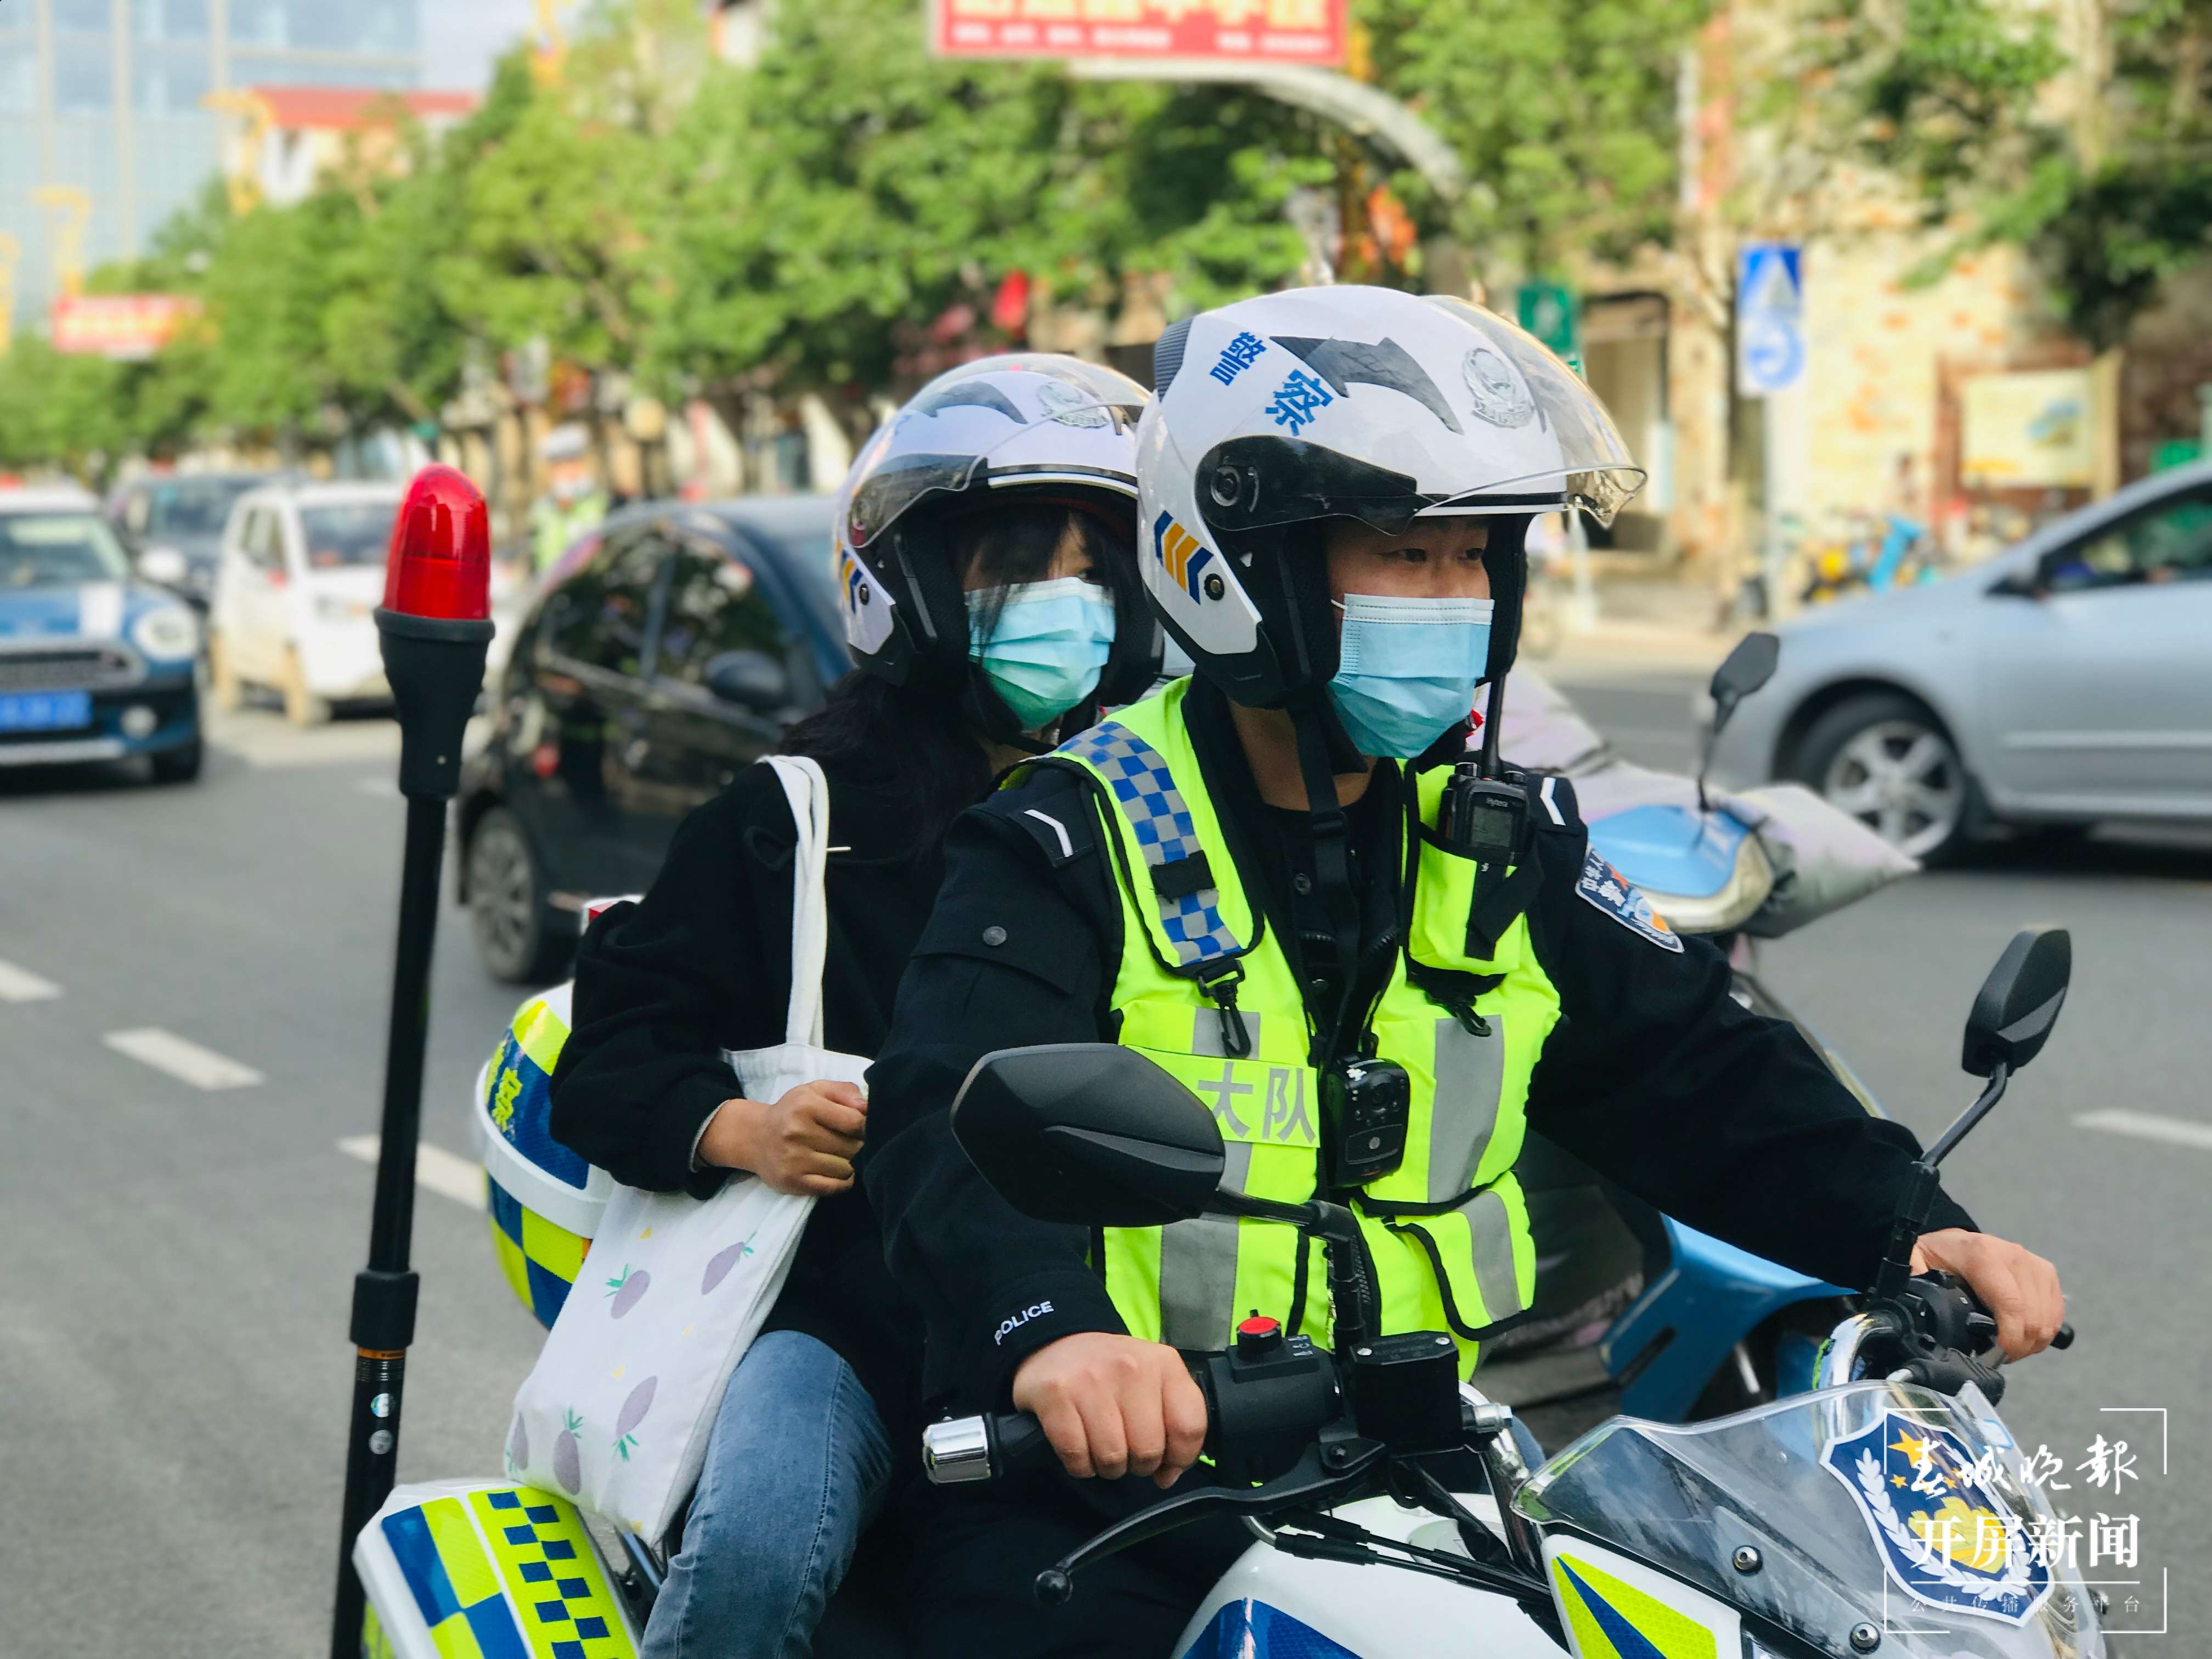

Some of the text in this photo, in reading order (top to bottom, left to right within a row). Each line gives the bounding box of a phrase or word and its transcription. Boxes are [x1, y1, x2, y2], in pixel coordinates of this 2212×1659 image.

[1210, 332, 1334, 437] 警察
[1197, 1061, 1317, 1144] 大队
[994, 1301, 1054, 1345] POLICE
